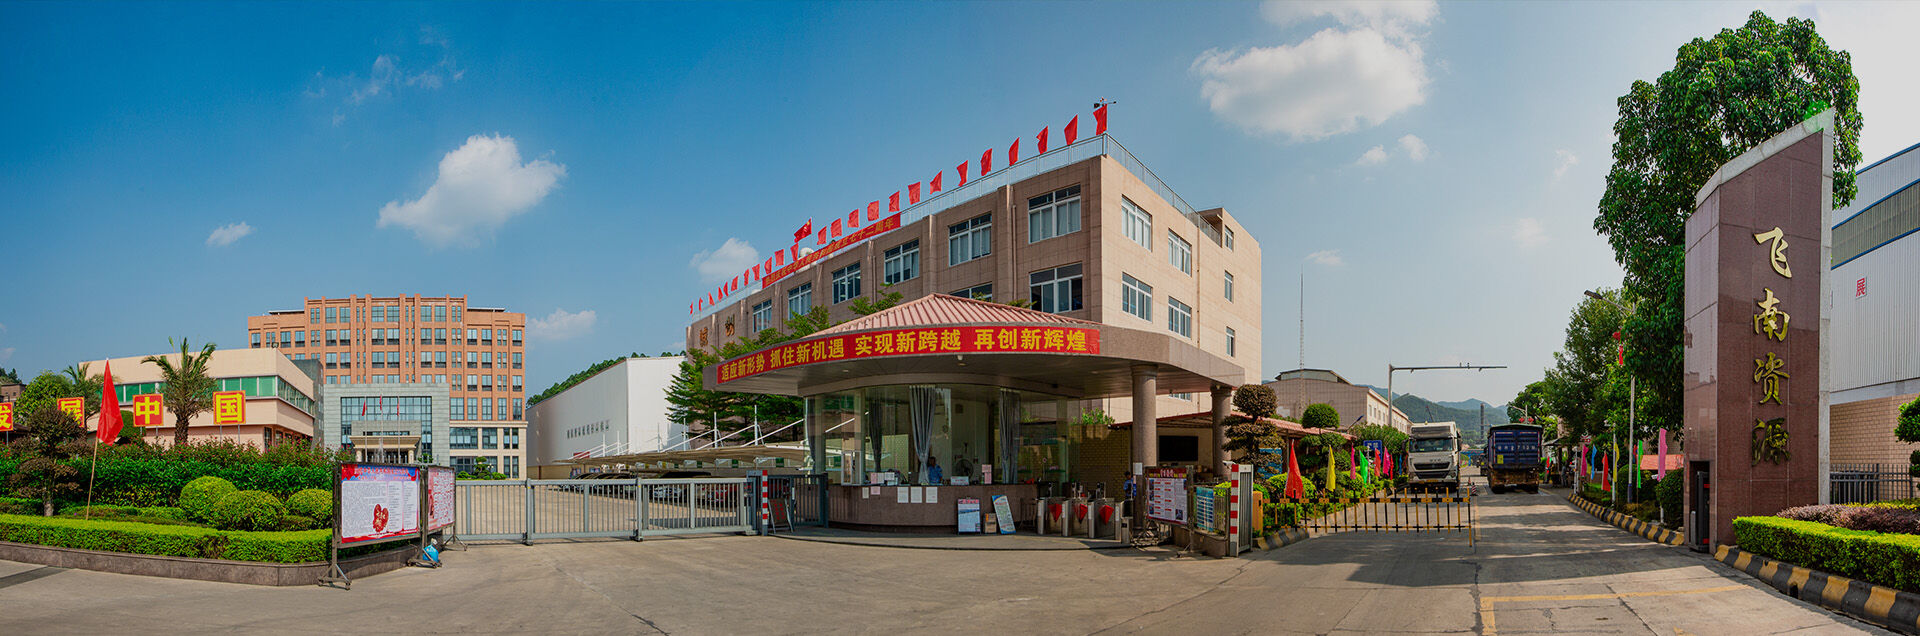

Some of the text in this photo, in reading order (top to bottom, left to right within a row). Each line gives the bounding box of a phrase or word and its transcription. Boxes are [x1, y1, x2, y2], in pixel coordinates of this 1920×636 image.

[721, 328, 1087, 381] 适应新形势 抓住新机遇 实现新跨越 再创新辉煌
[1754, 227, 1792, 467] 飞南资源
[135, 396, 160, 425] 中
[215, 393, 243, 423] 国
